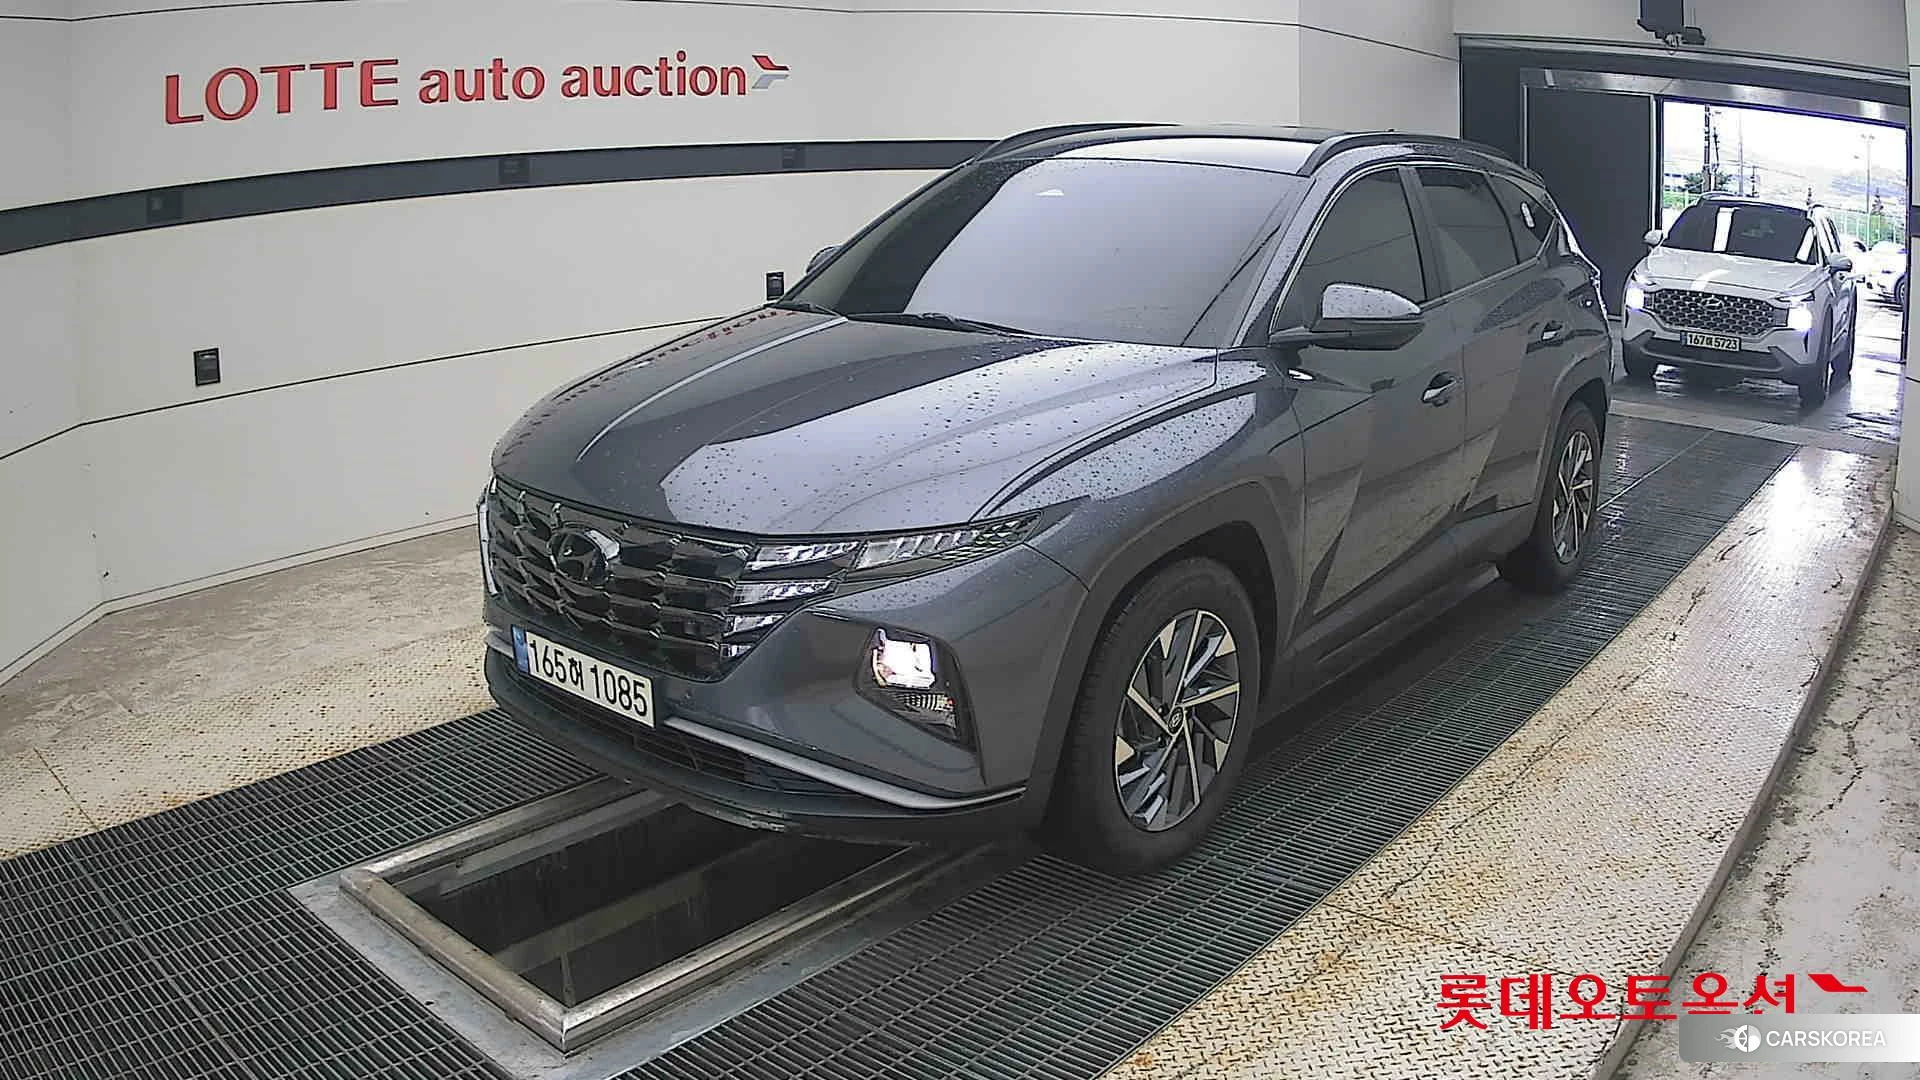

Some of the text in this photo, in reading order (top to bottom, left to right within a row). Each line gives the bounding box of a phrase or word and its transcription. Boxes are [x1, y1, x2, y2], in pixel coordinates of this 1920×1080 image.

[165, 50, 748, 125] LOTTE auto auction
[1714, 337, 1738, 350] 5723
[529, 639, 648, 717] 165허 1085
